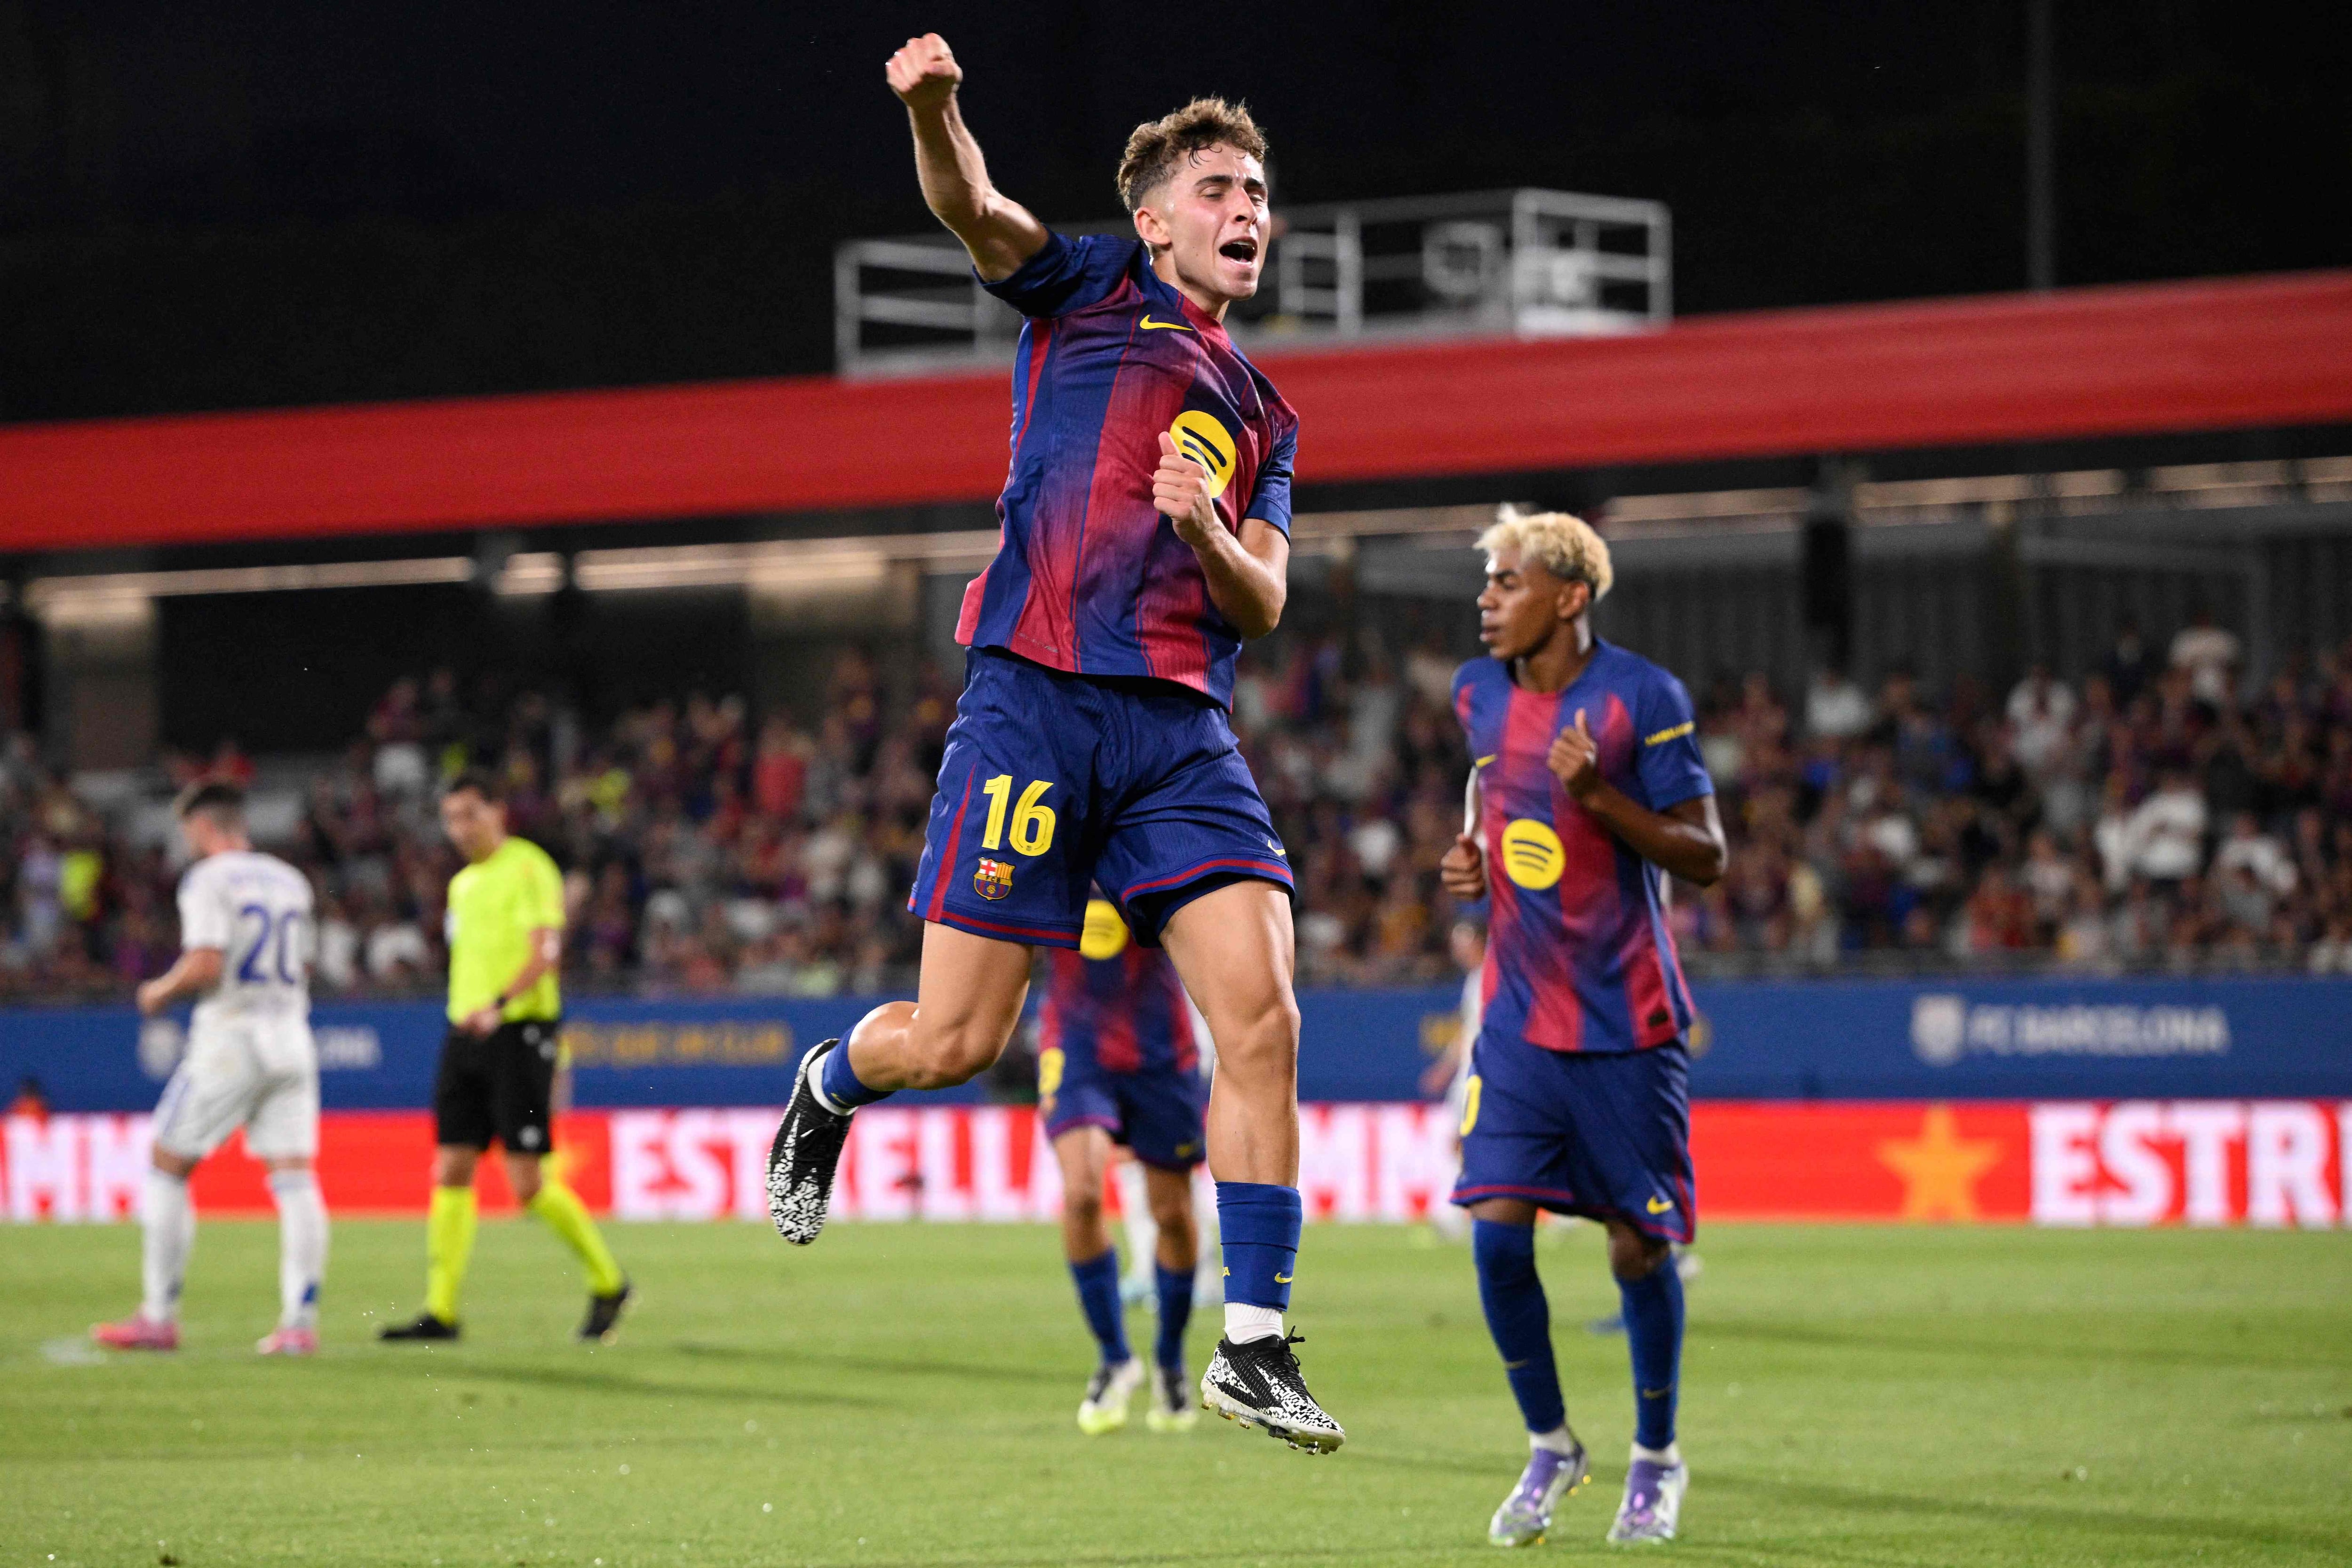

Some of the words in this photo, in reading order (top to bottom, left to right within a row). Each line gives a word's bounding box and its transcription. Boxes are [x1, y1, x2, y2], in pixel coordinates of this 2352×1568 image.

[982, 774, 1056, 856] 16
[239, 903, 307, 984] 20
[2030, 1101, 2352, 1226] ESTR
